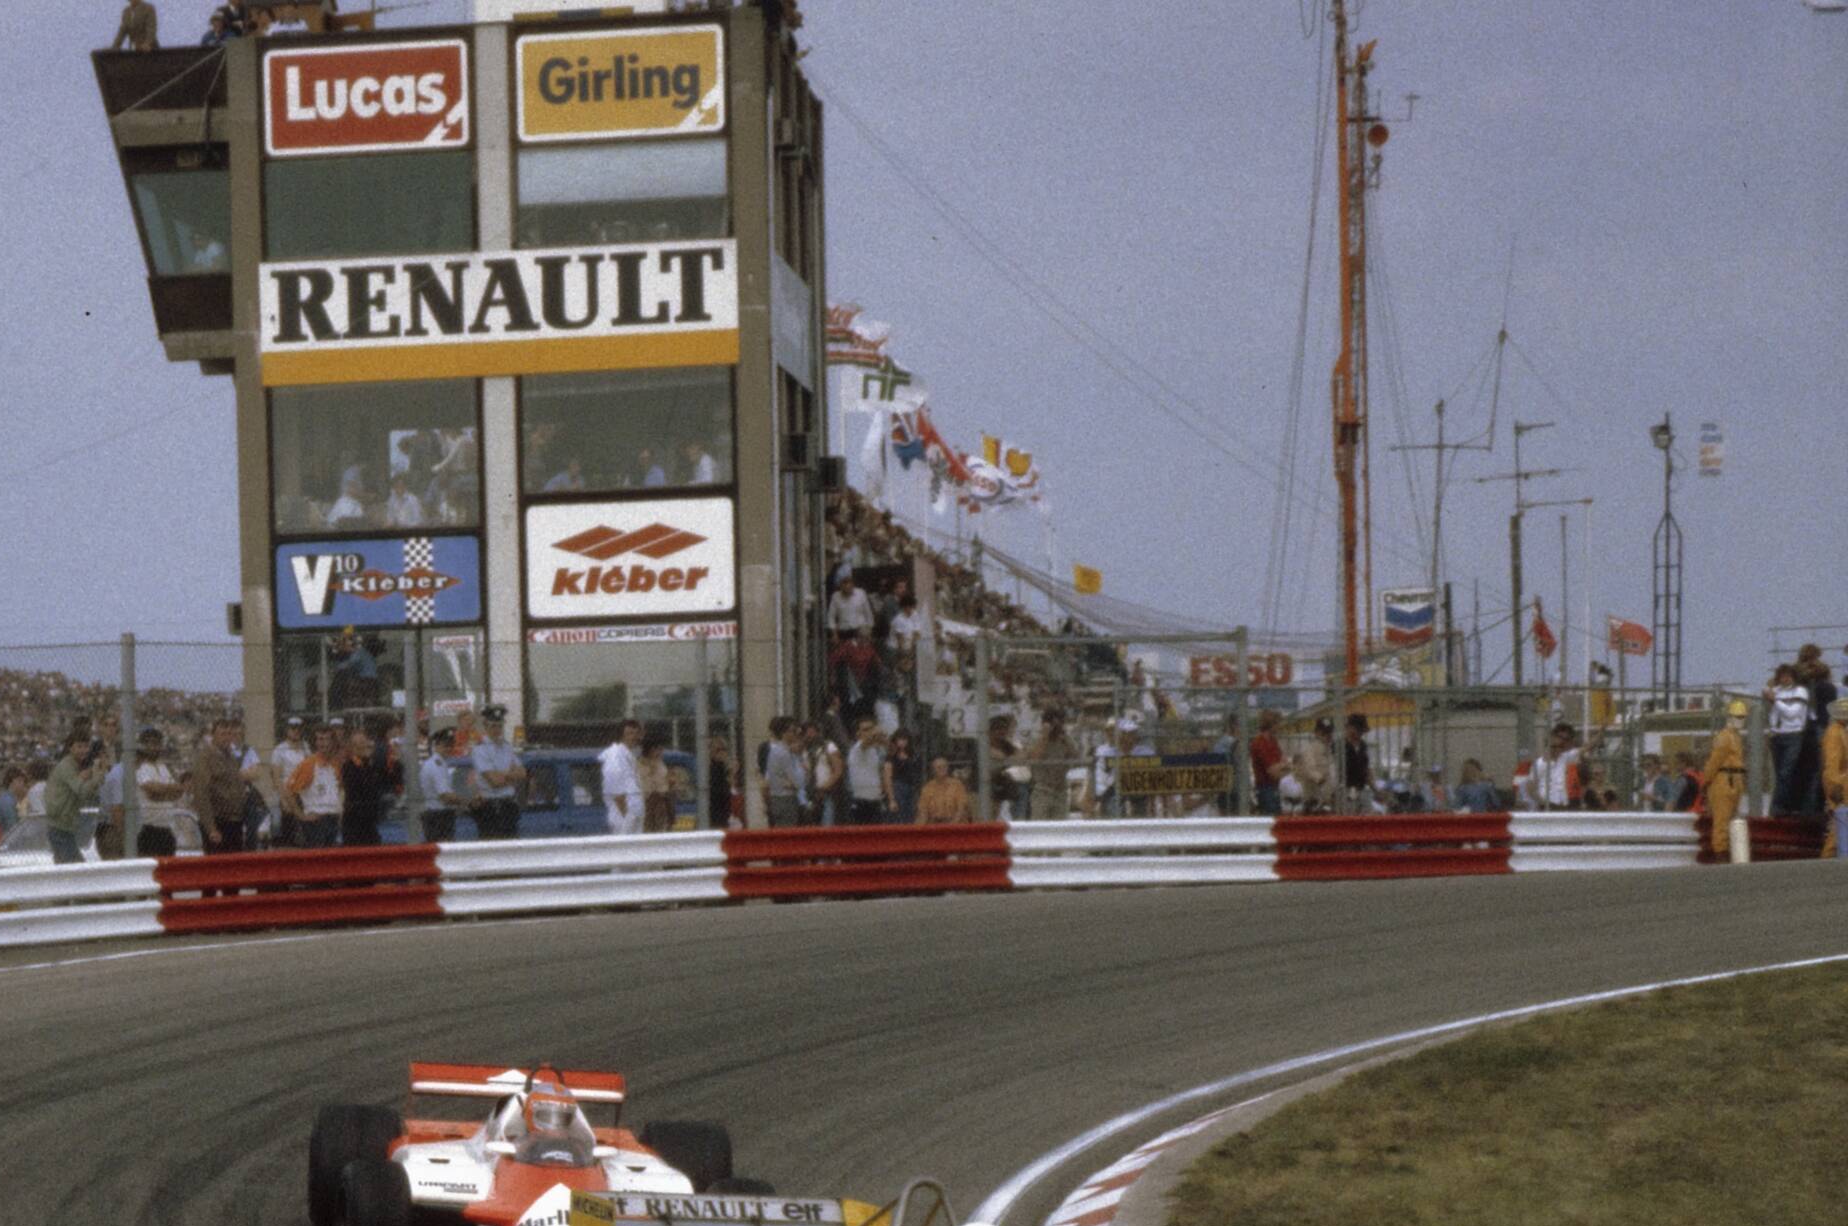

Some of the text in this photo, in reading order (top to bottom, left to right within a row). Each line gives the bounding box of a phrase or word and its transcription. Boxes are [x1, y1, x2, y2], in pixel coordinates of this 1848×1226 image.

[285, 66, 446, 121] Lucas
[538, 54, 700, 109] Girling
[270, 247, 725, 344] RENAULT
[527, 627, 597, 643] Canon
[645, 1198, 768, 1221] RENAULT
[781, 1203, 824, 1222] elf
